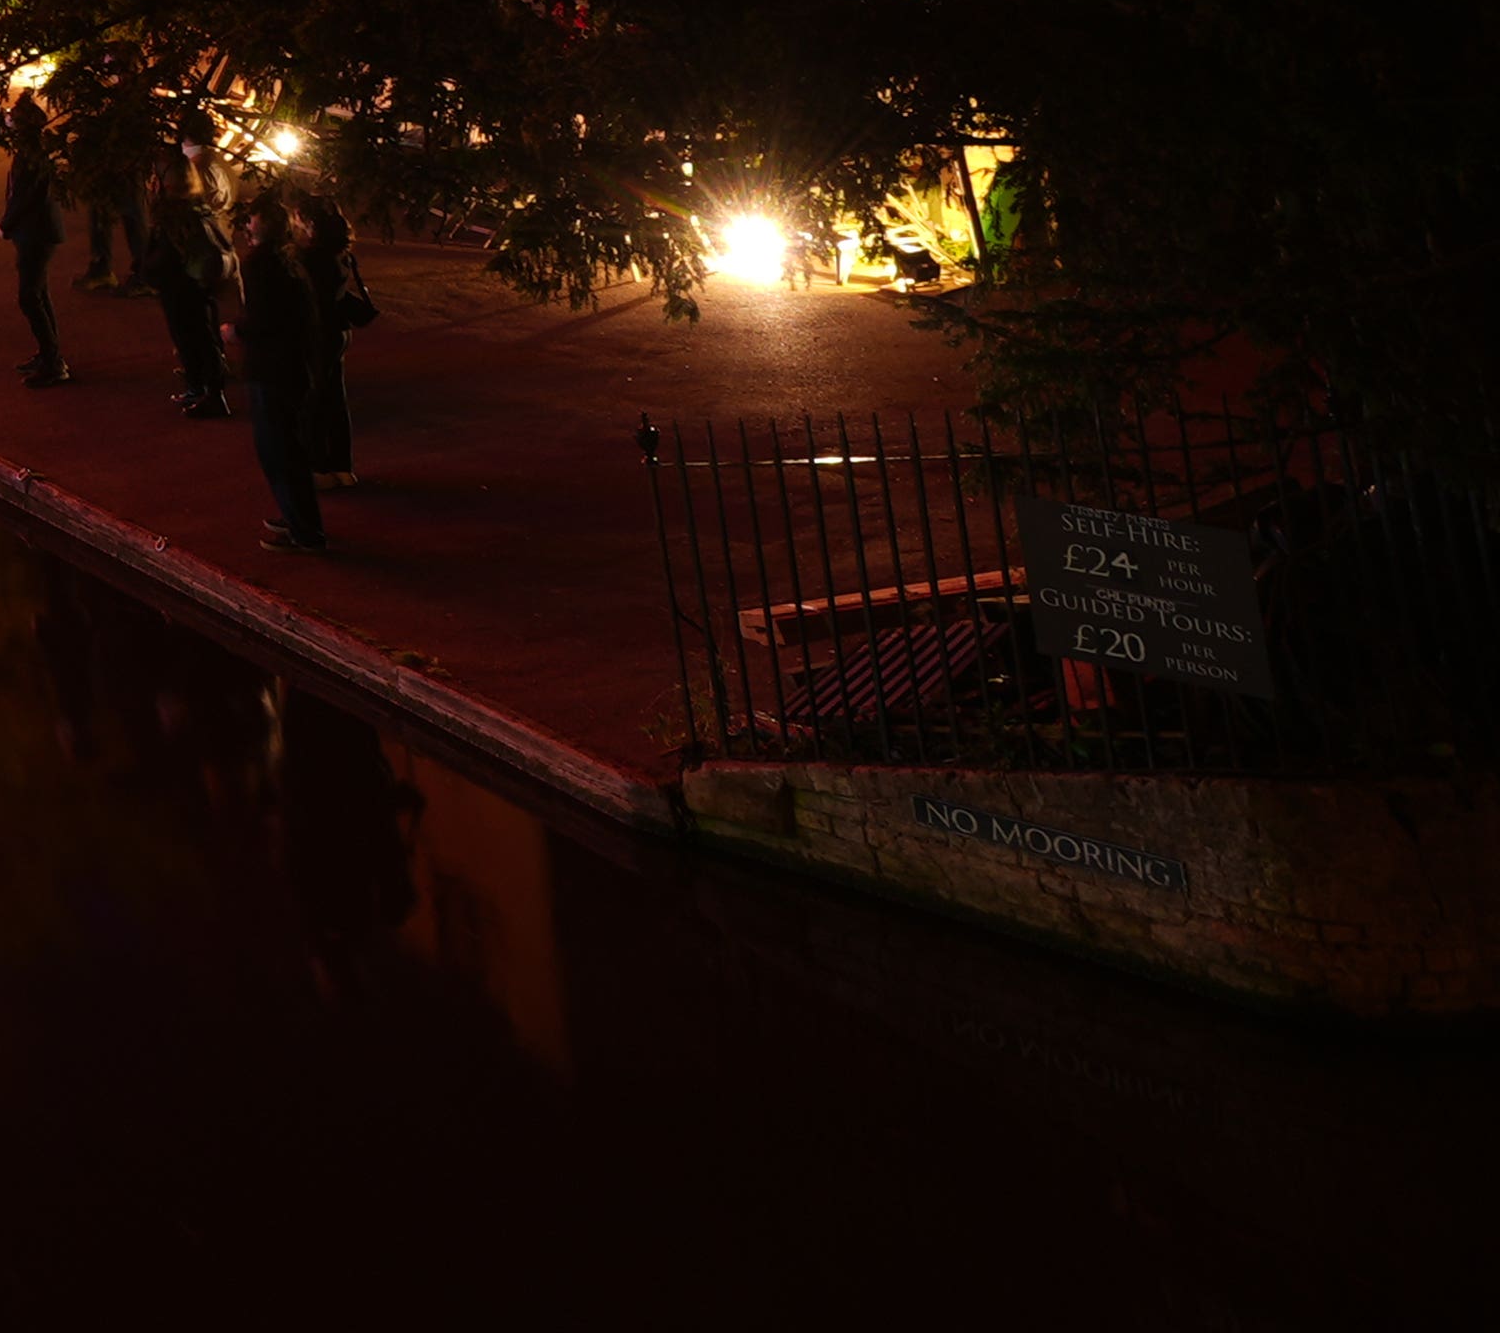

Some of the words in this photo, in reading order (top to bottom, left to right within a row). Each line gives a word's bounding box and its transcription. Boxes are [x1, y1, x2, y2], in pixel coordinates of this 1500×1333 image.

[1061, 512, 1201, 553] SELF-HIRE:
[1063, 543, 1140, 581] £24
[1166, 558, 1202, 577] PER
[1158, 576, 1219, 597] HOUR
[1039, 587, 1145, 622] GUIDED
[1156, 608, 1253, 644] TOURS:
[1127, 593, 1176, 613] PUNTS
[1072, 623, 1146, 663] £20
[1181, 642, 1217, 661] PER
[1164, 656, 1239, 683] PERSON
[924, 800, 979, 835] NO
[990, 817, 1171, 886] MOORING
